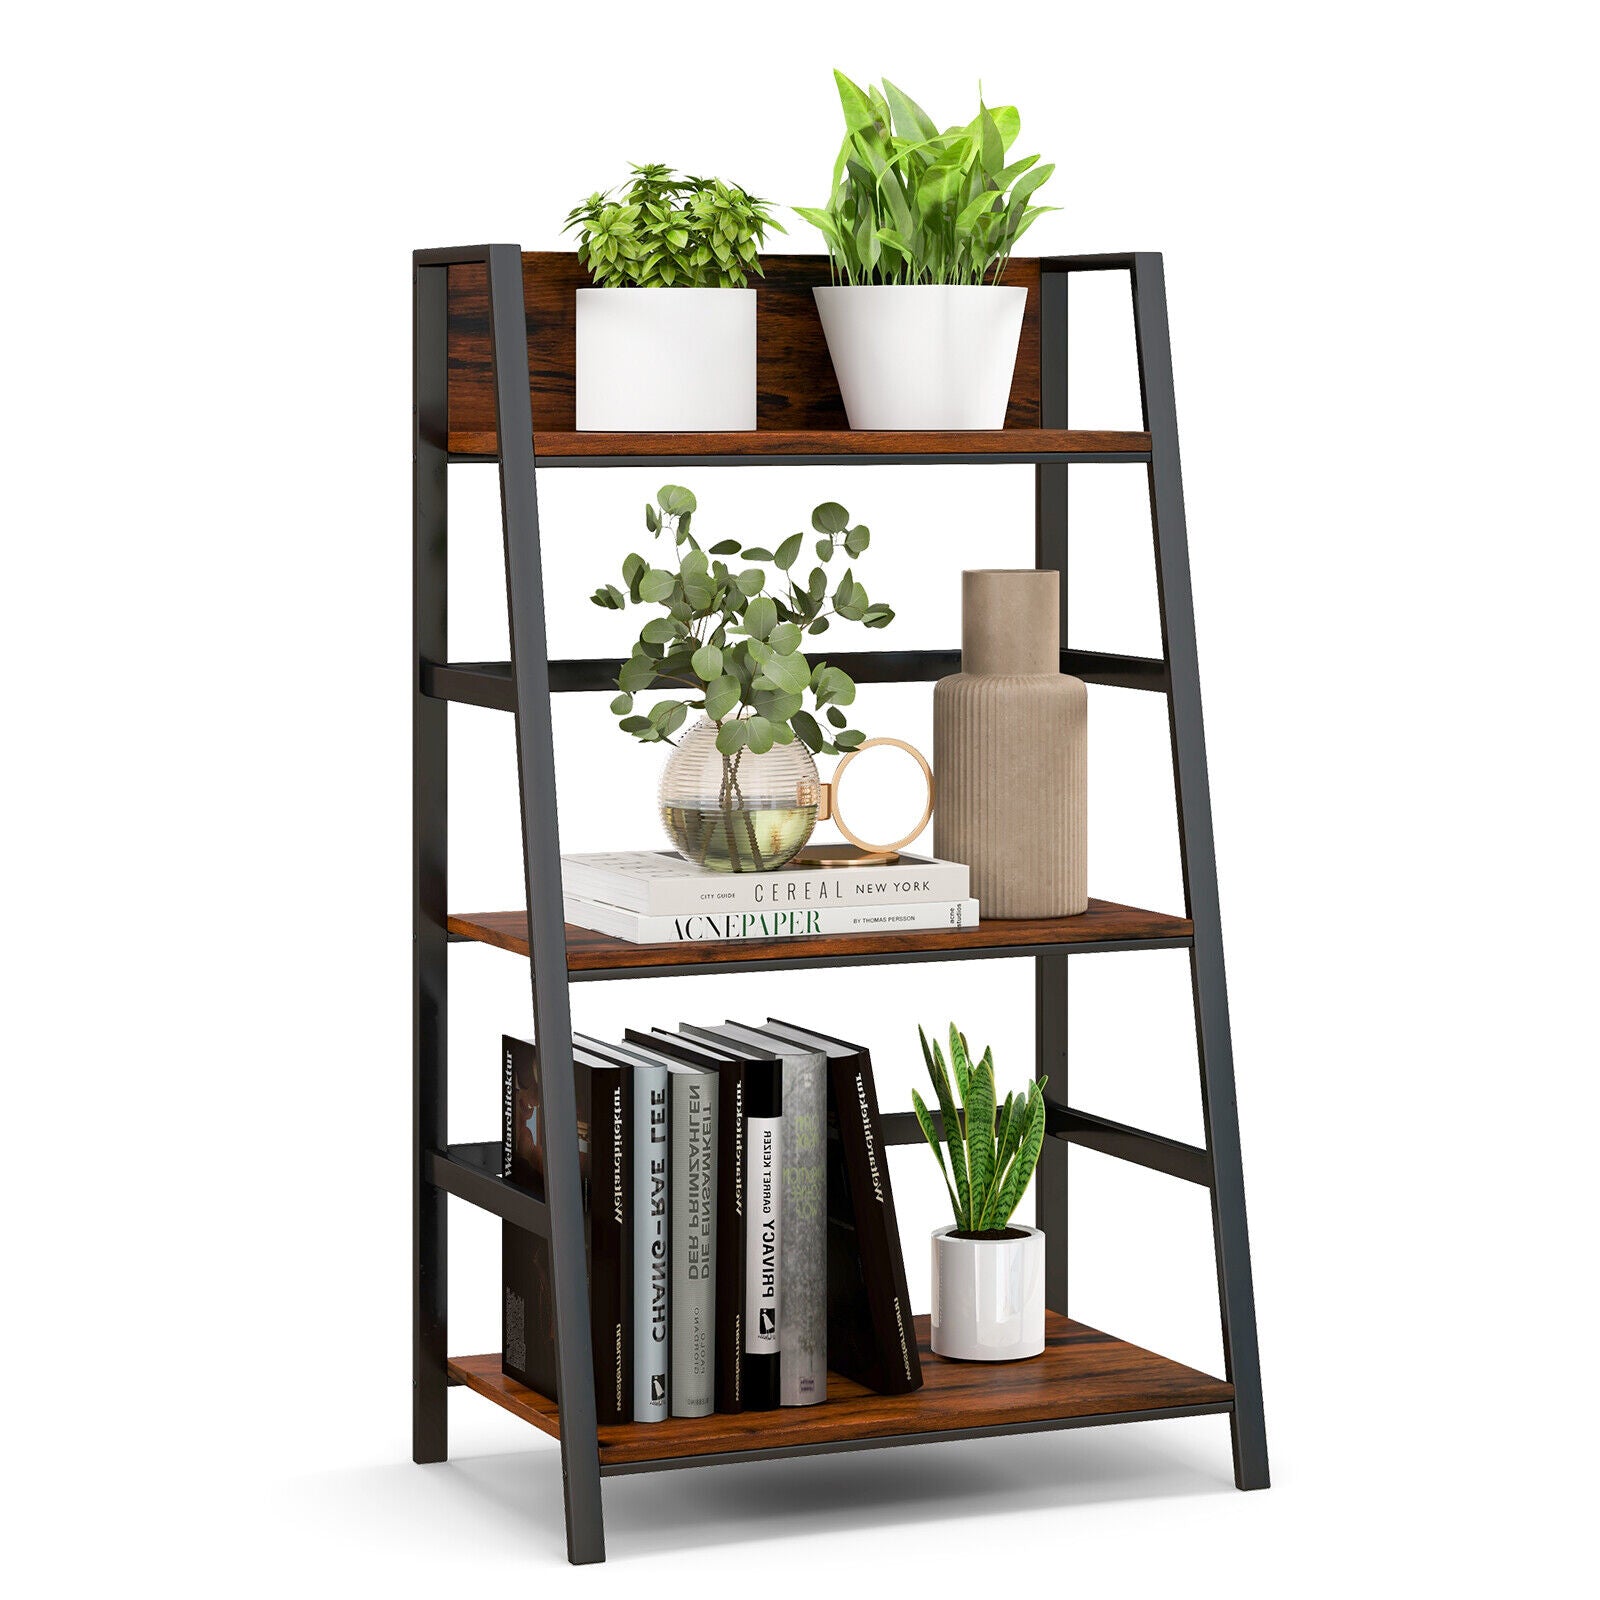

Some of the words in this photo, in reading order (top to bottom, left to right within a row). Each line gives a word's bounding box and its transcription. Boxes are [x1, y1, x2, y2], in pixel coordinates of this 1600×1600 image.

[716, 892, 736, 900] GUIDE
[754, 880, 843, 903] CEREAL
[855, 883, 888, 894] NEW
[893, 880, 930, 892] YORK
[668, 910, 821, 941] ACNEPAPER
[504, 1050, 513, 1177] Weltarchitektur
